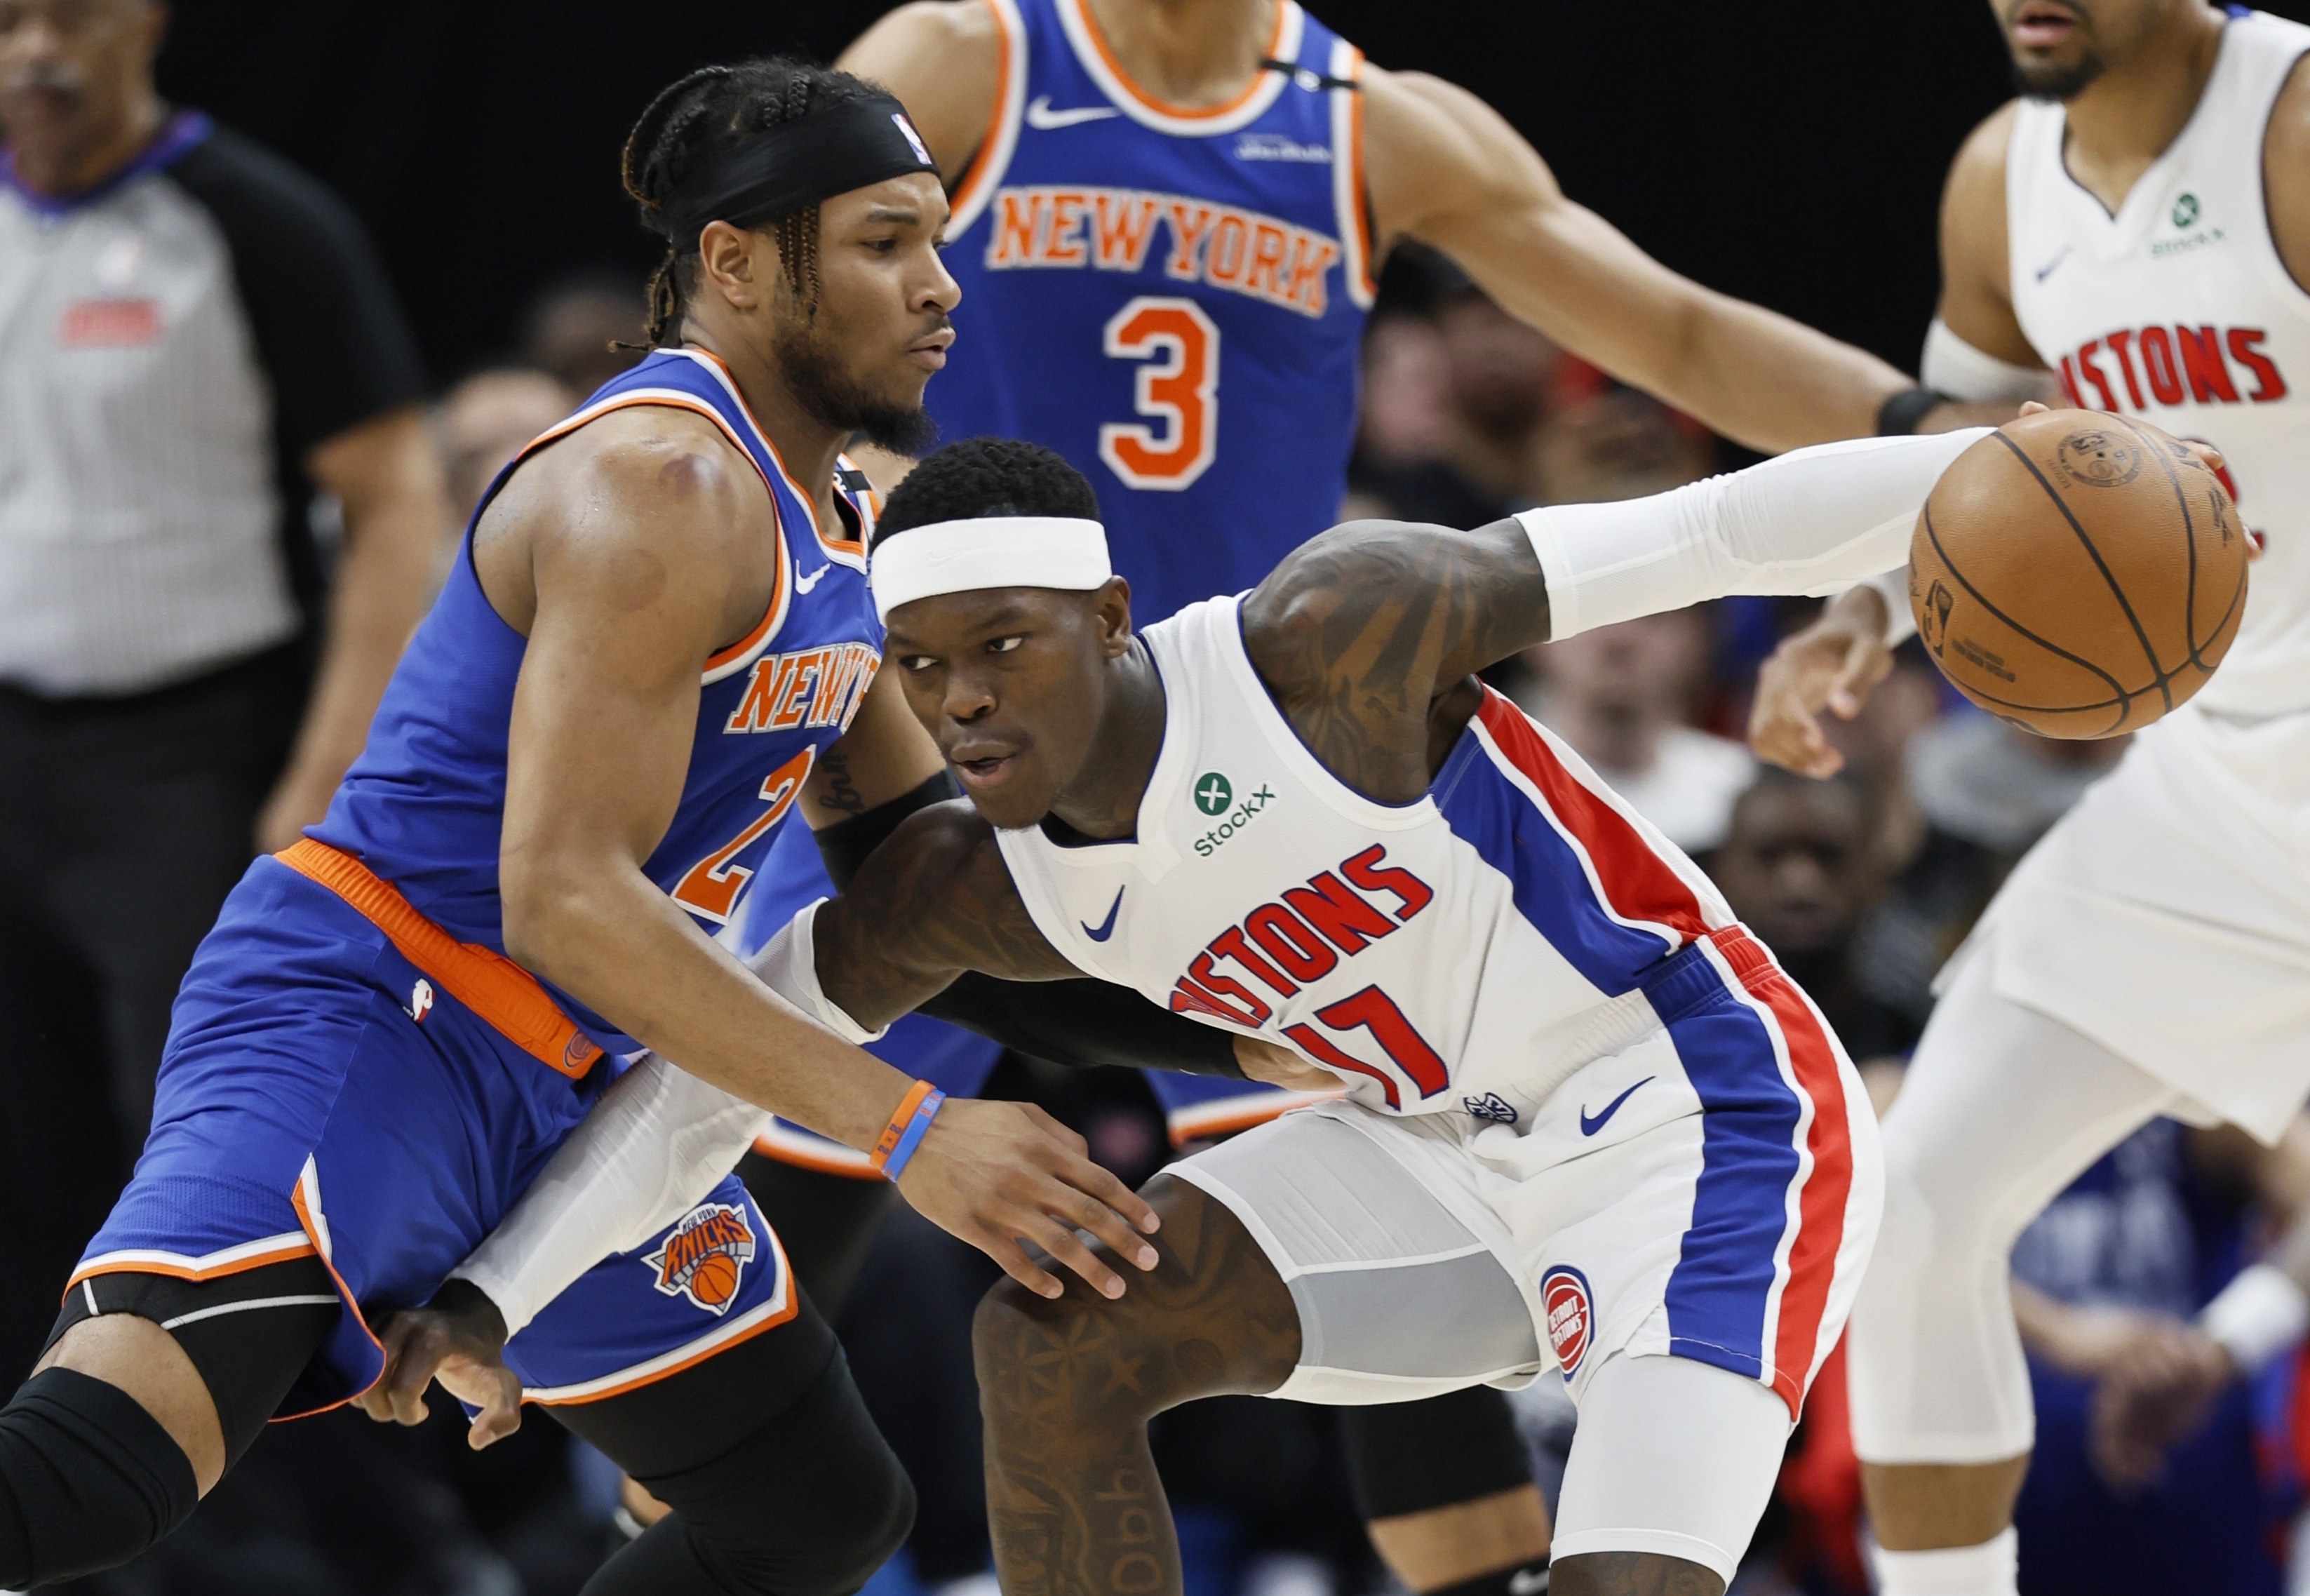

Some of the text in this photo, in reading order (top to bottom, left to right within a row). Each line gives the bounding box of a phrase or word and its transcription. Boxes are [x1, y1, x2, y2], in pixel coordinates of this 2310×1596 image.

[987, 187, 1338, 318] NEW YORK
[1099, 295, 1220, 491] 3
[723, 643, 855, 735] NEW
[670, 743, 817, 927] 2
[1279, 984, 1450, 1112] 17
[661, 1209, 753, 1287] KNICKS
